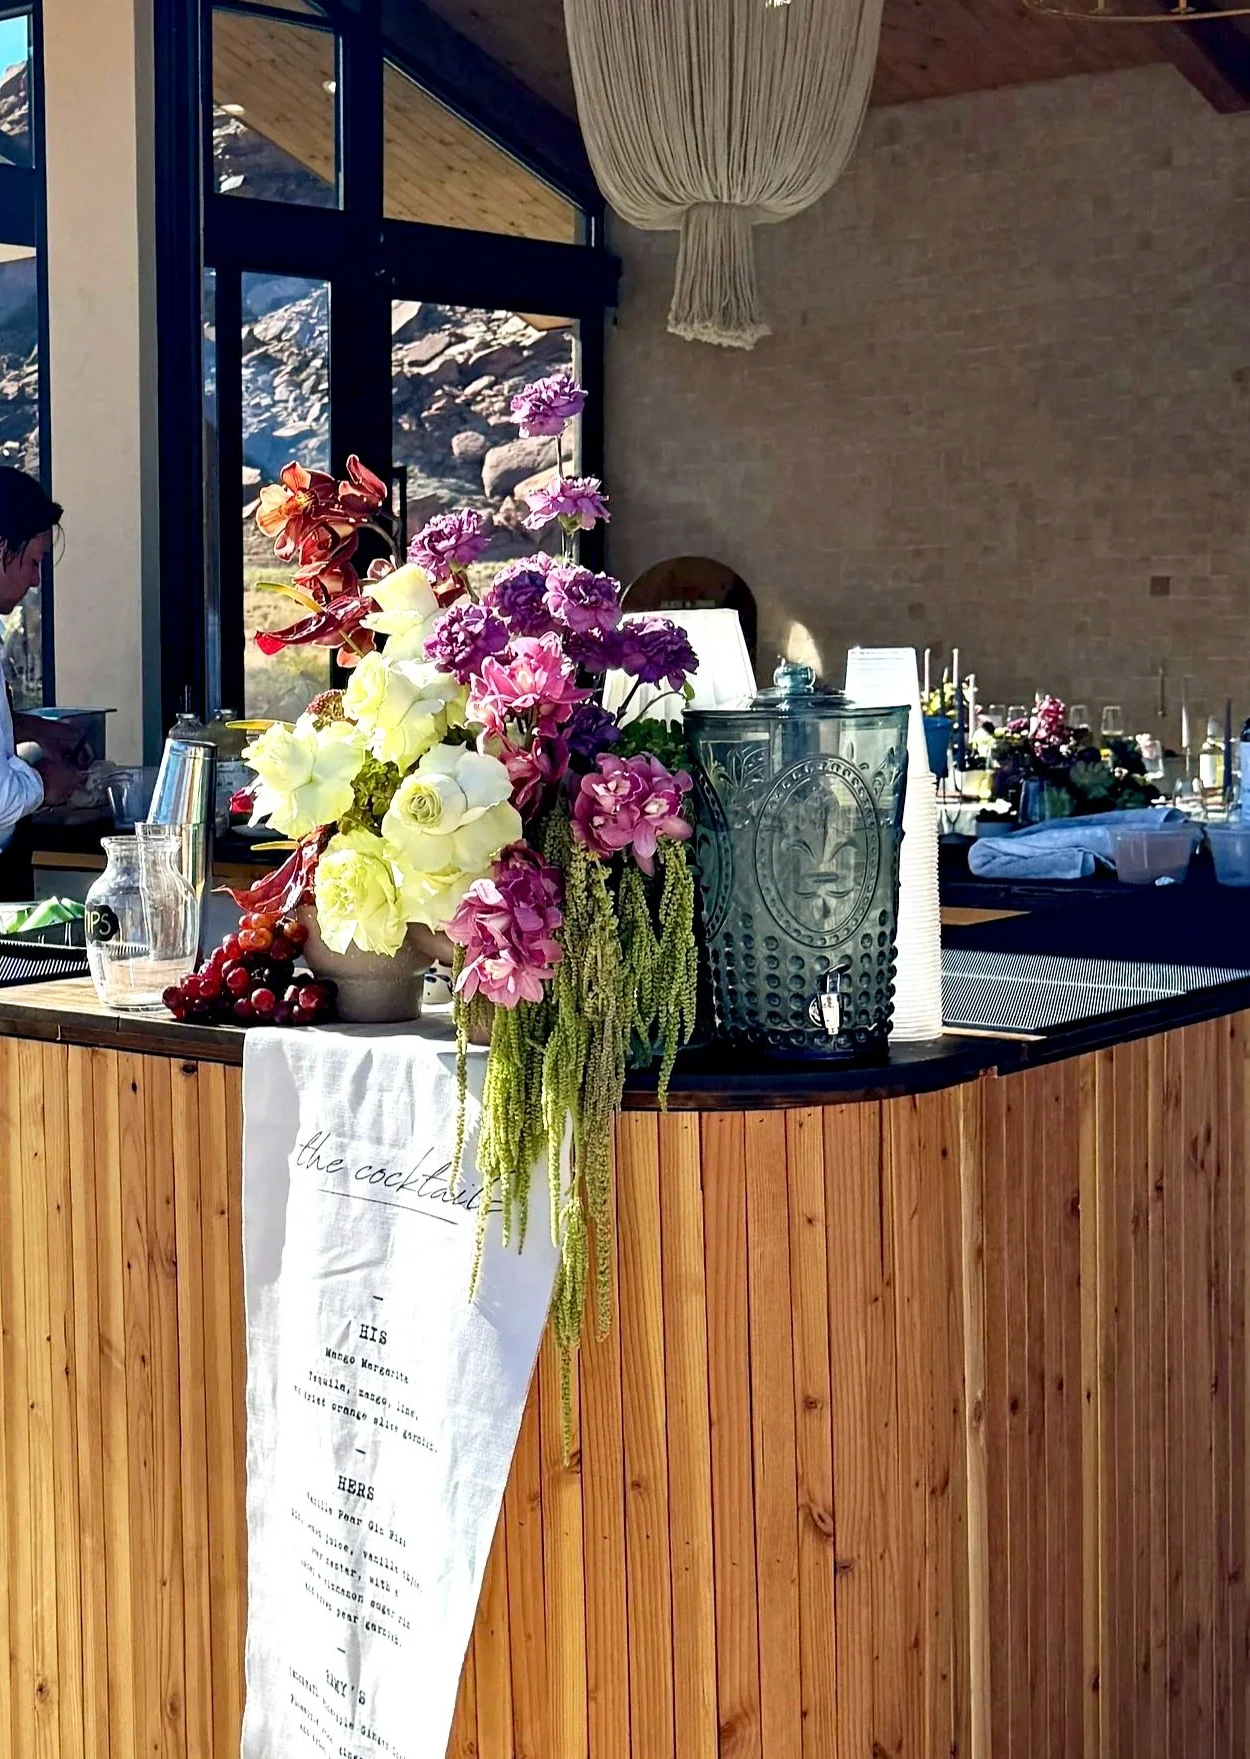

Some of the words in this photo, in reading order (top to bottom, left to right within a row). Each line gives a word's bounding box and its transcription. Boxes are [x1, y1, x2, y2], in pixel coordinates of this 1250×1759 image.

[86, 910, 112, 936] IPS
[297, 1131, 345, 1173] the
[359, 1323, 388, 1345] HIS
[325, 1346, 356, 1365] Mango
[331, 1402, 368, 1421] orange
[337, 1475, 375, 1501] HERS
